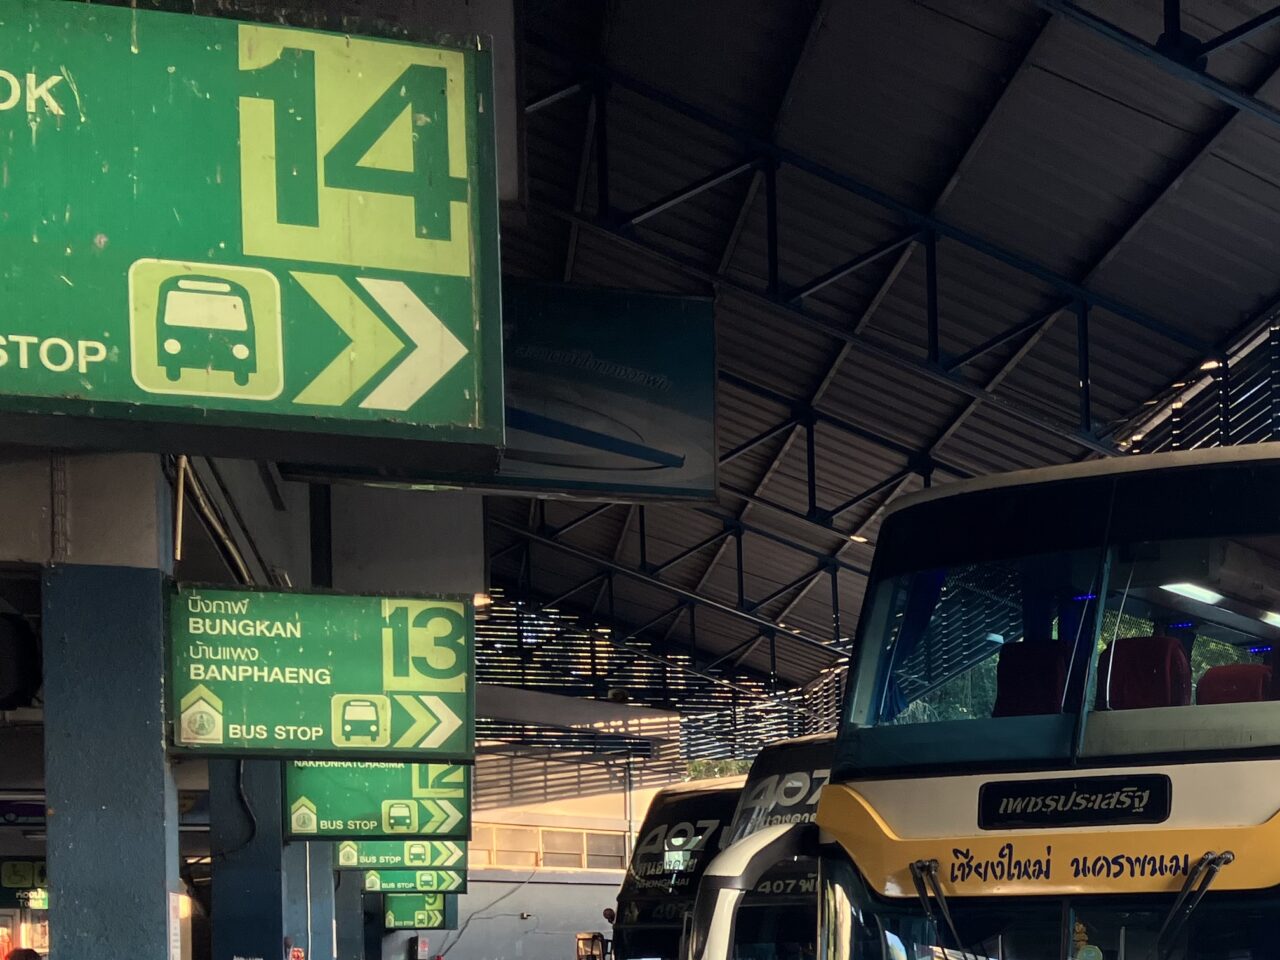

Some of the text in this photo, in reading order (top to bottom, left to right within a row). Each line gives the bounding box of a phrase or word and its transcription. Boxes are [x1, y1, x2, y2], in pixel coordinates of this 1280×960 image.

[239, 47, 468, 241] 14
[188, 617, 301, 638] BUNGKAN
[382, 606, 465, 680] 13
[189, 664, 332, 685] BANPHAENG
[228, 724, 268, 740] BUS
[274, 725, 324, 741] STOP
[742, 769, 829, 811] 407
[999, 785, 1151, 814] เพชรประเสริฐ
[319, 820, 378, 830] BUS STOP
[637, 819, 721, 854] 407
[360, 855, 402, 864] BUS STOP
[950, 842, 1190, 883] เชียงใหม่ นครพนม
[756, 879, 797, 894] 407
